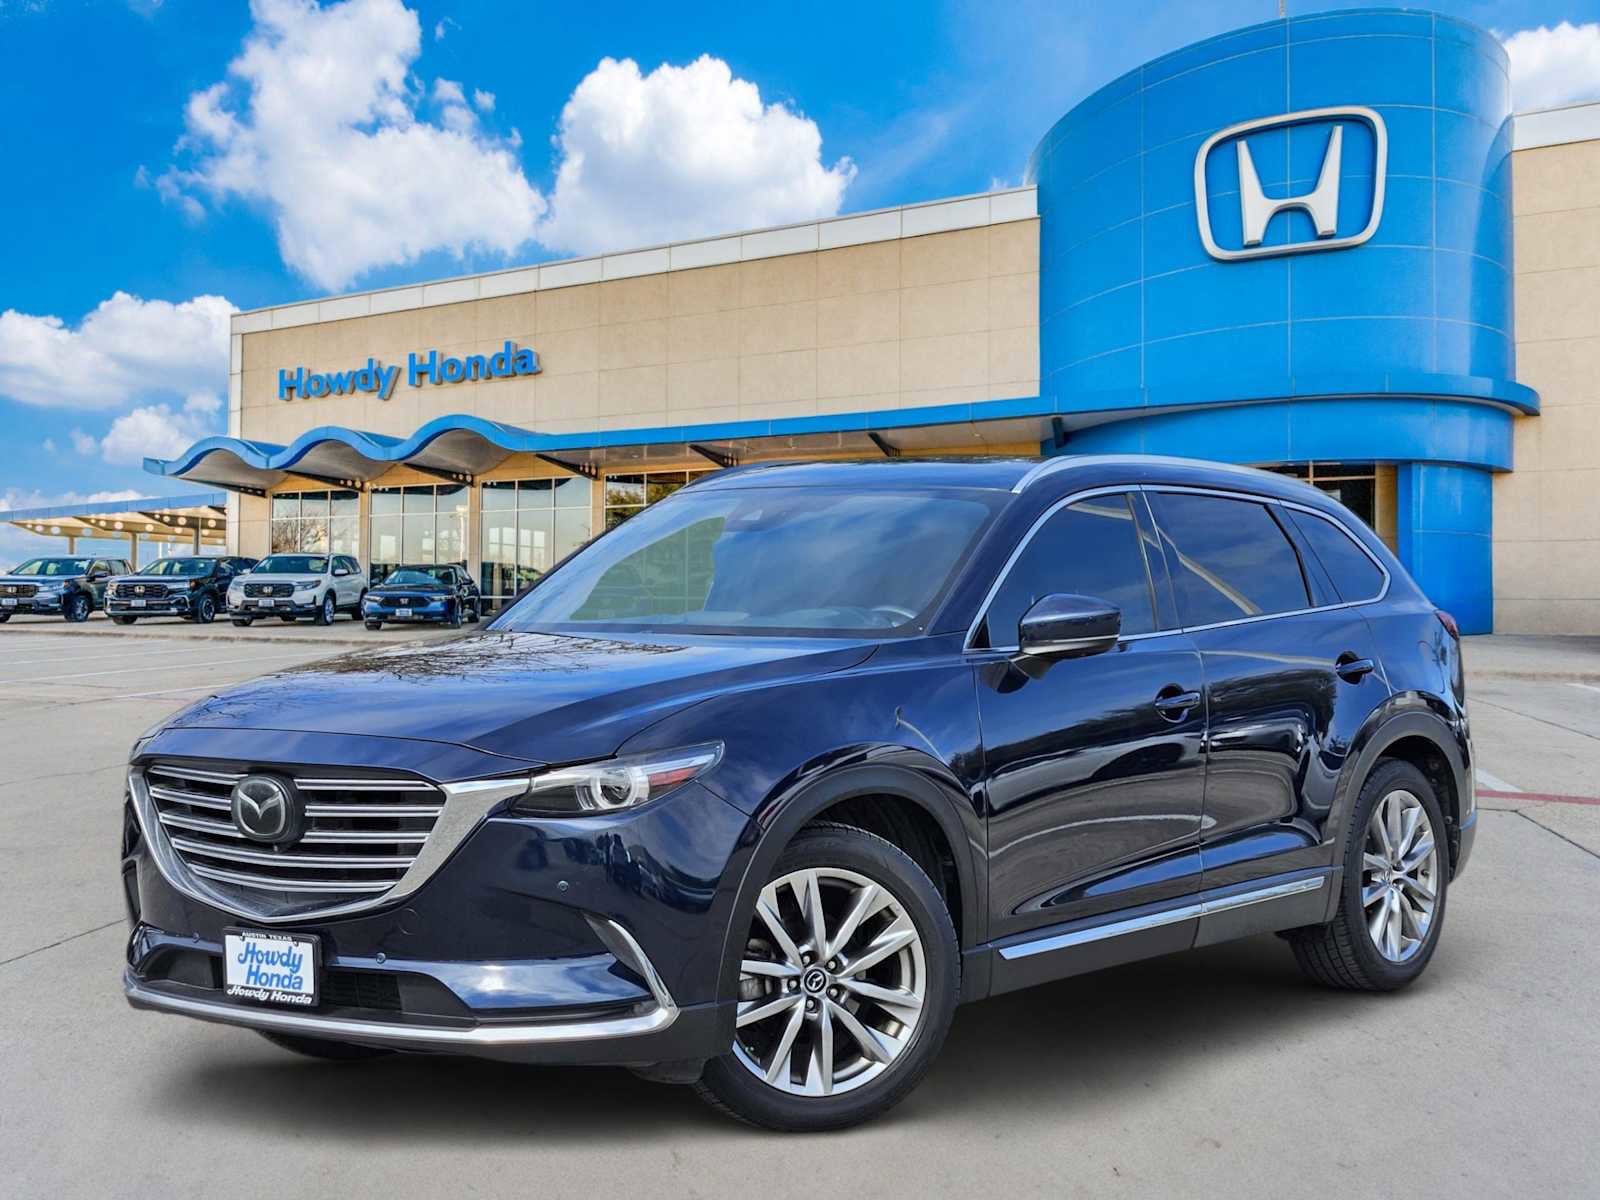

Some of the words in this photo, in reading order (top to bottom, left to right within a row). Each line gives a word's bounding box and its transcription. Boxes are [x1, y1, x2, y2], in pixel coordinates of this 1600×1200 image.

[278, 357, 401, 401] Howdy
[407, 340, 542, 388] Honda
[241, 931, 267, 940] AUSTIN
[269, 933, 293, 942] TEXAS
[237, 941, 303, 974] Howdy
[245, 963, 303, 991] Honda
[226, 985, 270, 1001] Howdy
[270, 990, 312, 1004] Honda
